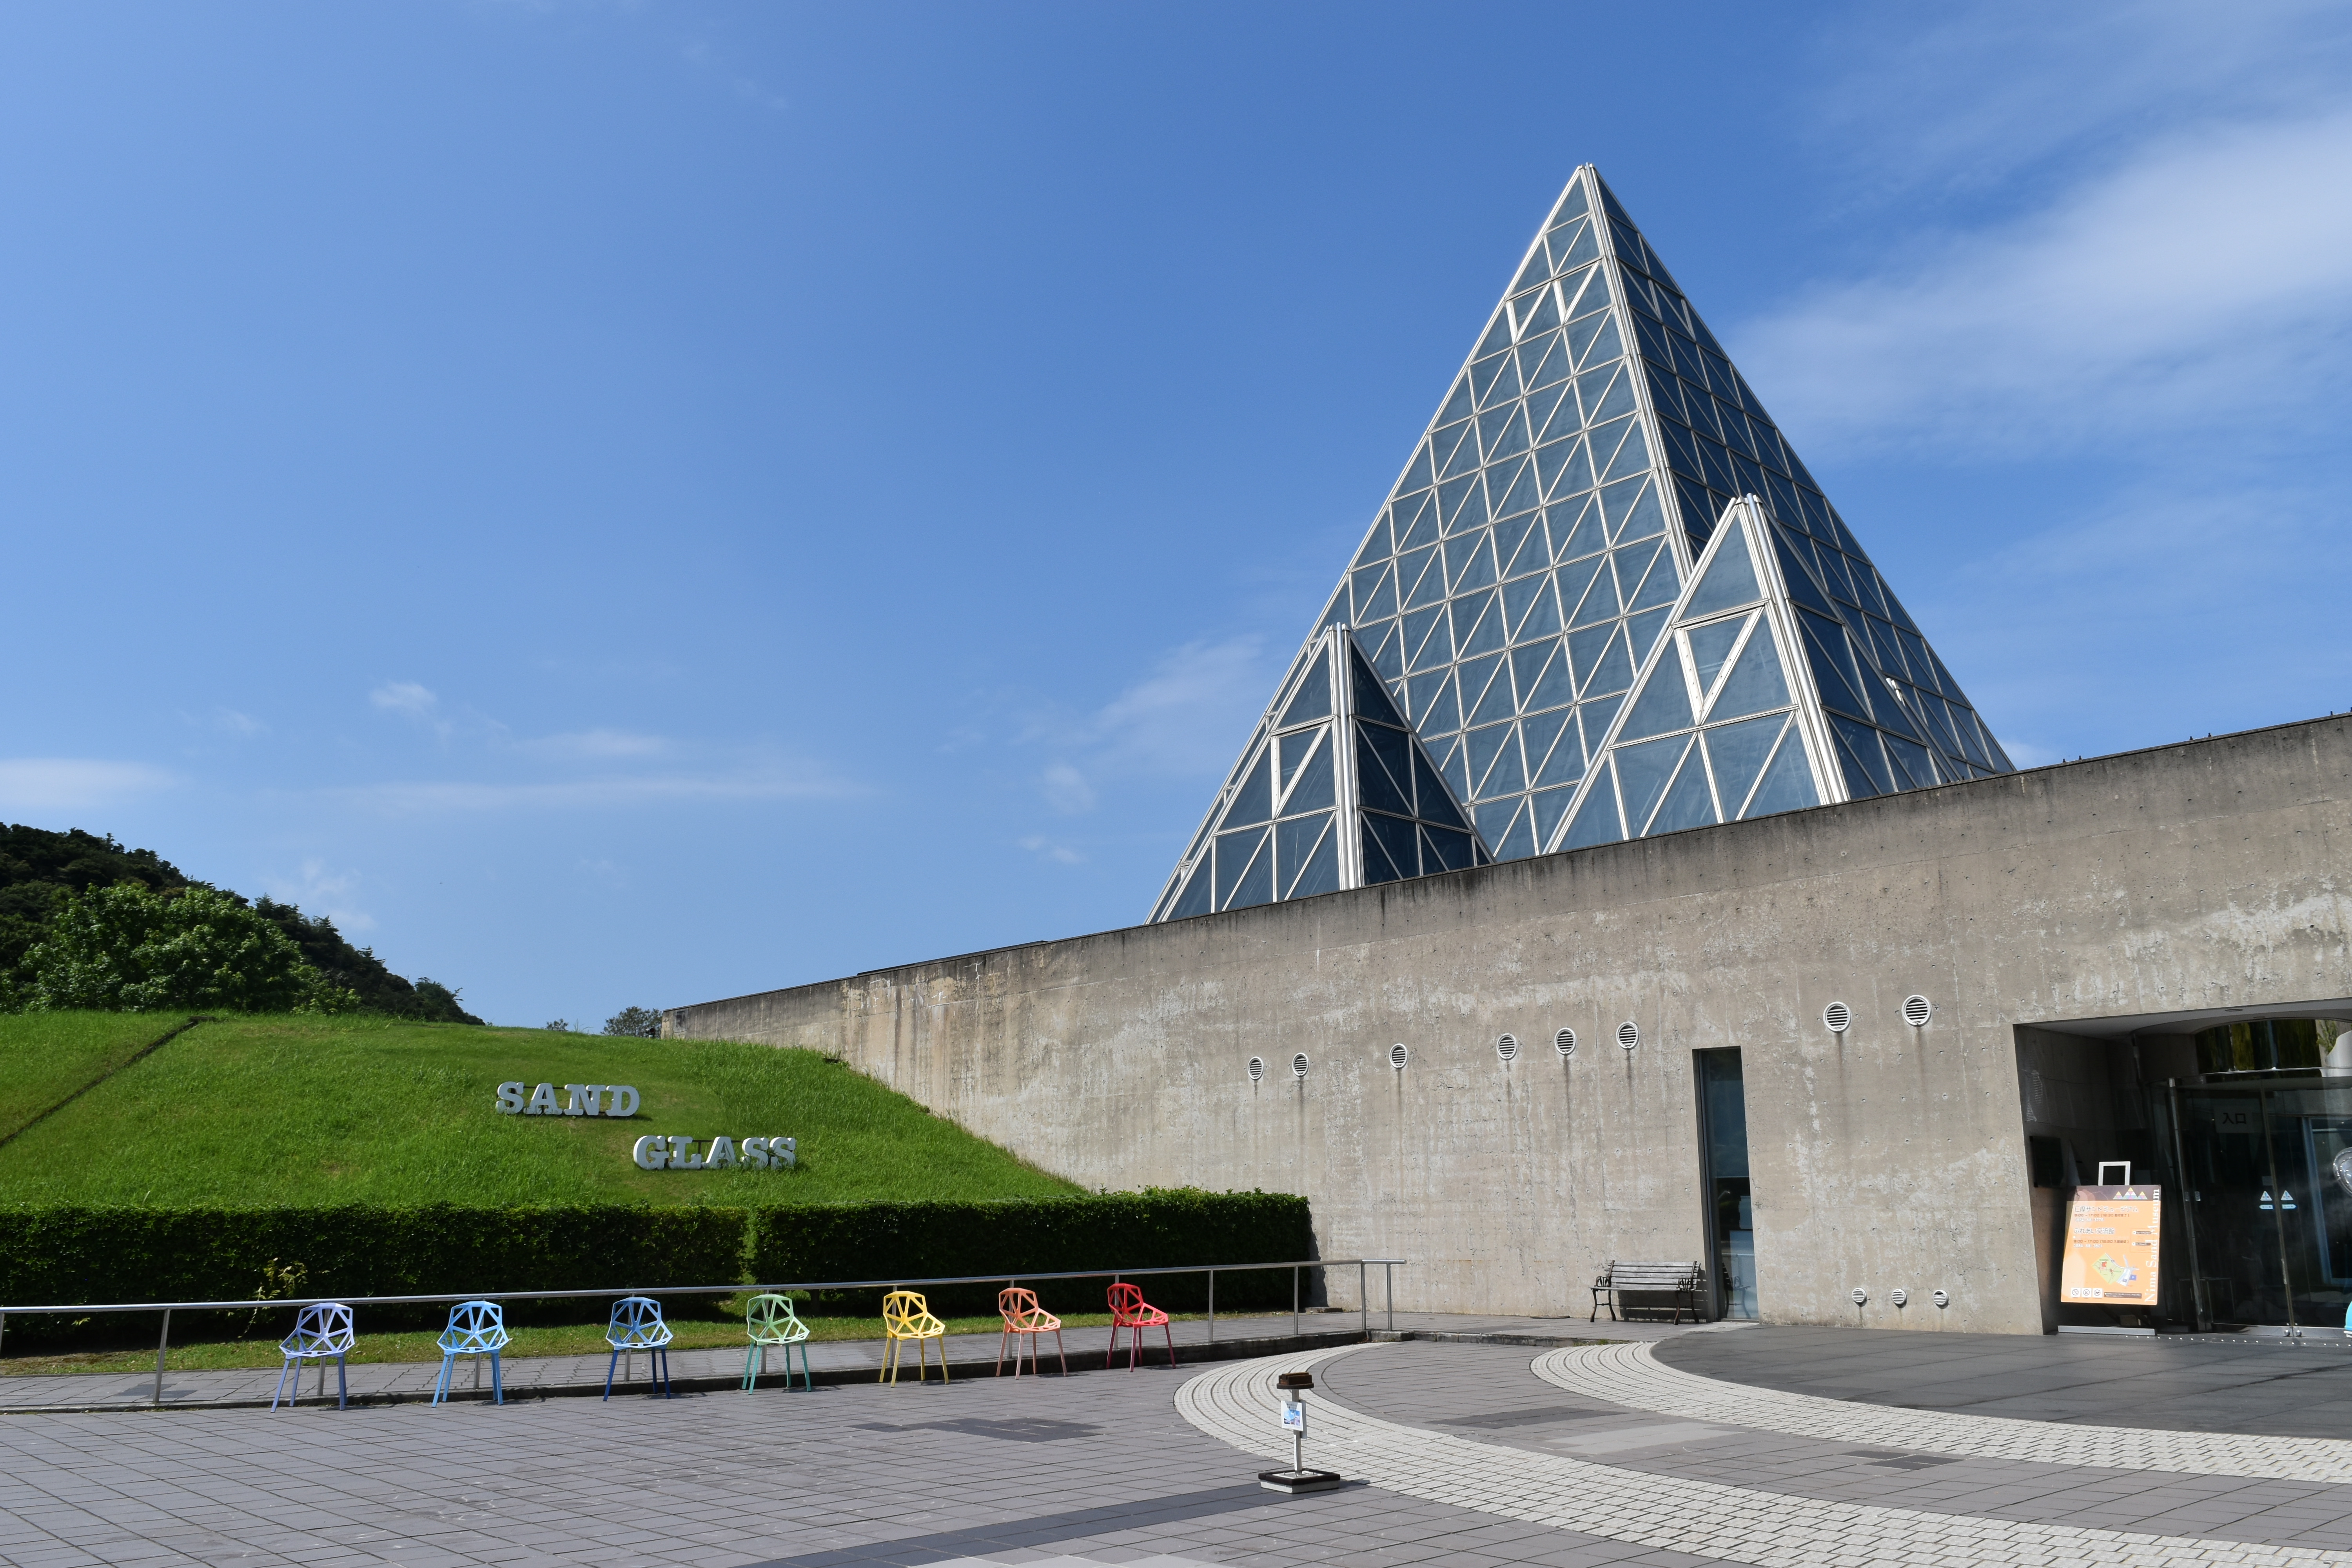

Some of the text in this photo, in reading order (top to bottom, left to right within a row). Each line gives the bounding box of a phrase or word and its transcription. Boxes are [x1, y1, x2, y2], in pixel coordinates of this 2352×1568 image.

[495, 1082, 640, 1117] SAND
[2222, 1113, 2247, 1124] 入口
[633, 1135, 796, 1170] GLASS
[2145, 1189, 2159, 1302] Nima Sand Museum
